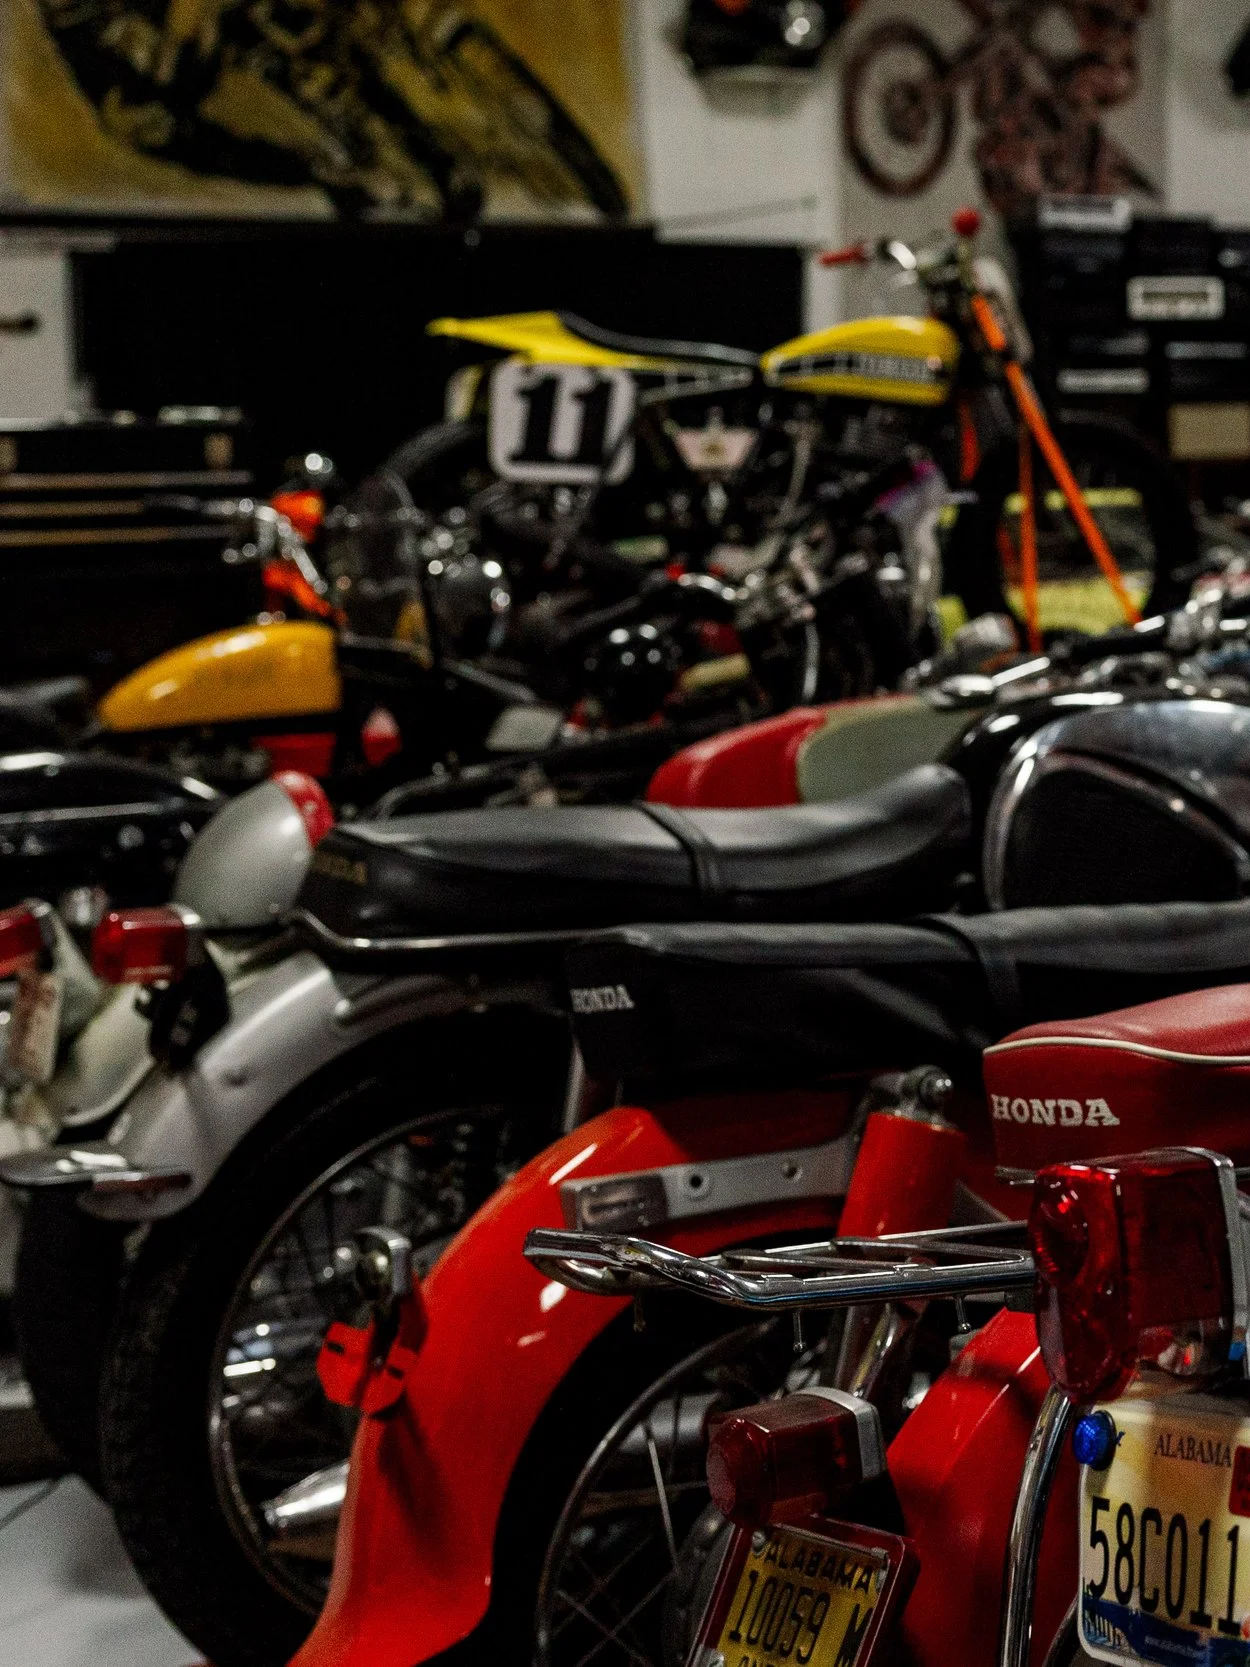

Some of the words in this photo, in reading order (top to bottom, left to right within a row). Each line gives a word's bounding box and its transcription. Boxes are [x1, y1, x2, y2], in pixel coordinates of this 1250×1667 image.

[511, 374, 610, 464] 11
[569, 984, 636, 1014] HONDA
[990, 1093, 1121, 1127] HONDA
[1154, 1433, 1232, 1467] ALABAMA
[764, 1539, 870, 1594] ALABAMA
[729, 1570, 830, 1664] 10059
